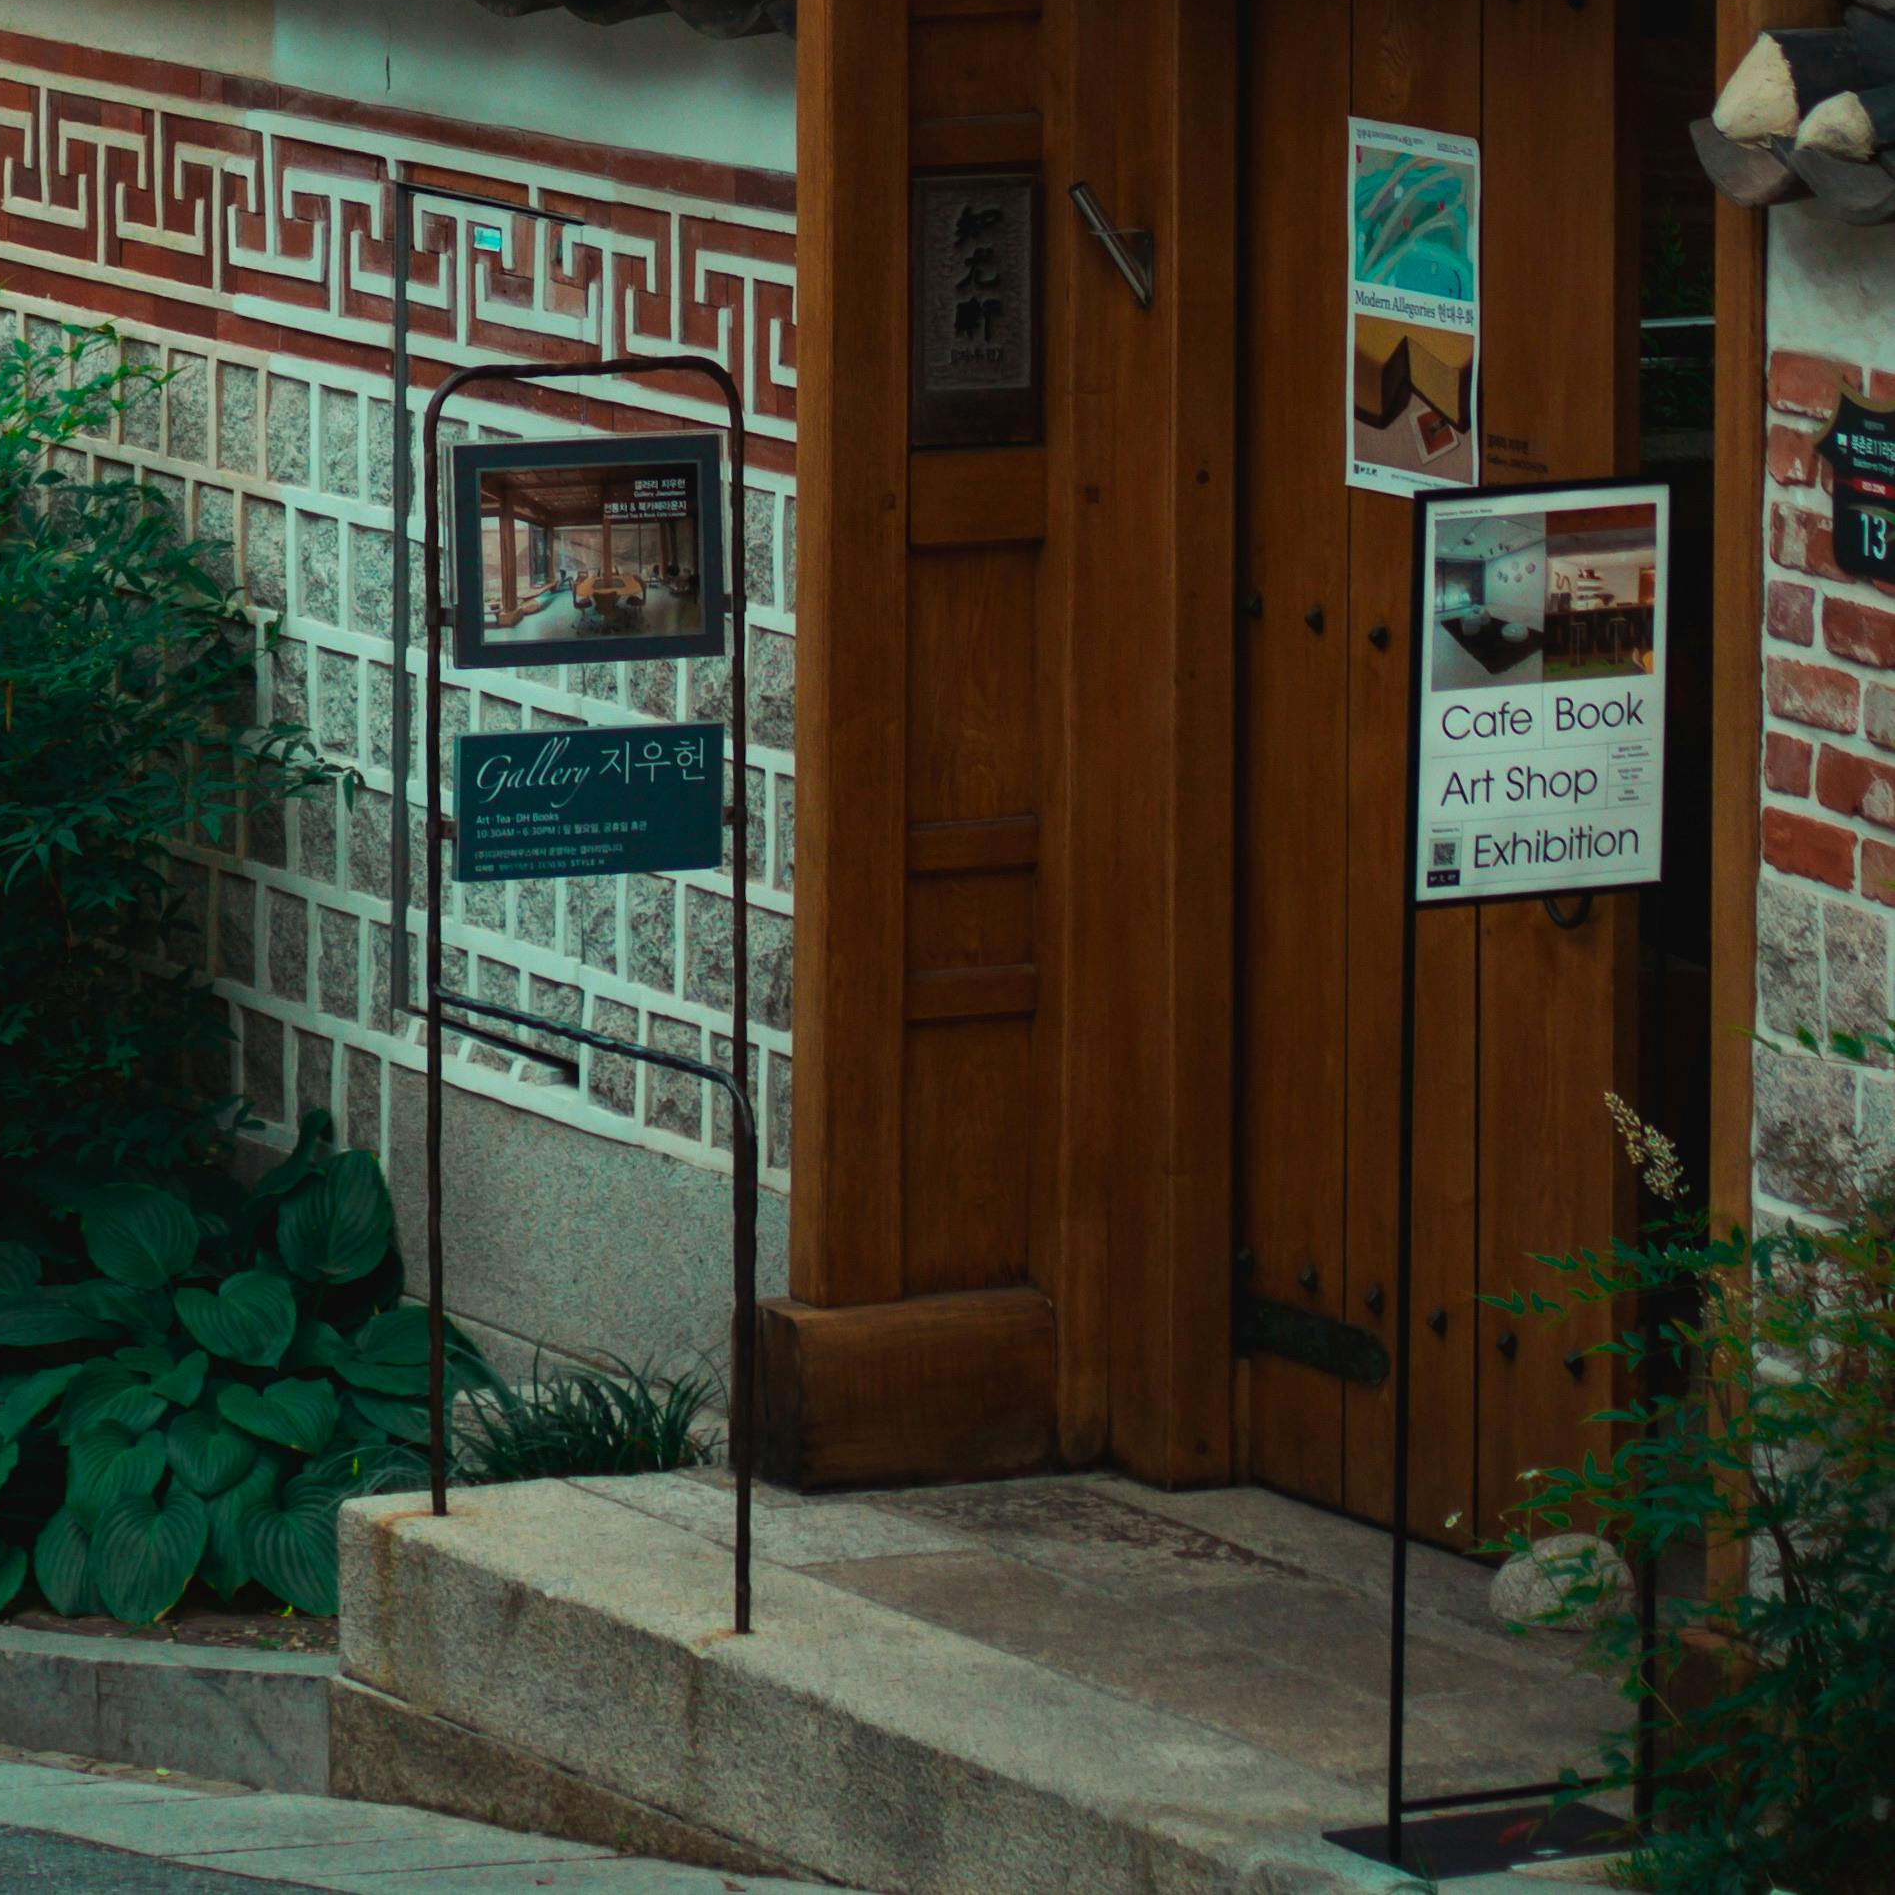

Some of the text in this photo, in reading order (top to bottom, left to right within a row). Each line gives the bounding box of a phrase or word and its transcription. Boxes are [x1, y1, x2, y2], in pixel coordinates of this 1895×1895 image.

[1354, 289, 1391, 310] Modern
[1392, 296, 1436, 319] Allegories
[1860, 512, 1887, 560] 13
[1441, 691, 1645, 741] Cafe Book
[476, 736, 706, 809] Gallery 지우헌
[1440, 765, 1599, 807] Art Shop
[532, 811, 560, 823] Books
[1473, 824, 1639, 869] Exhibition
